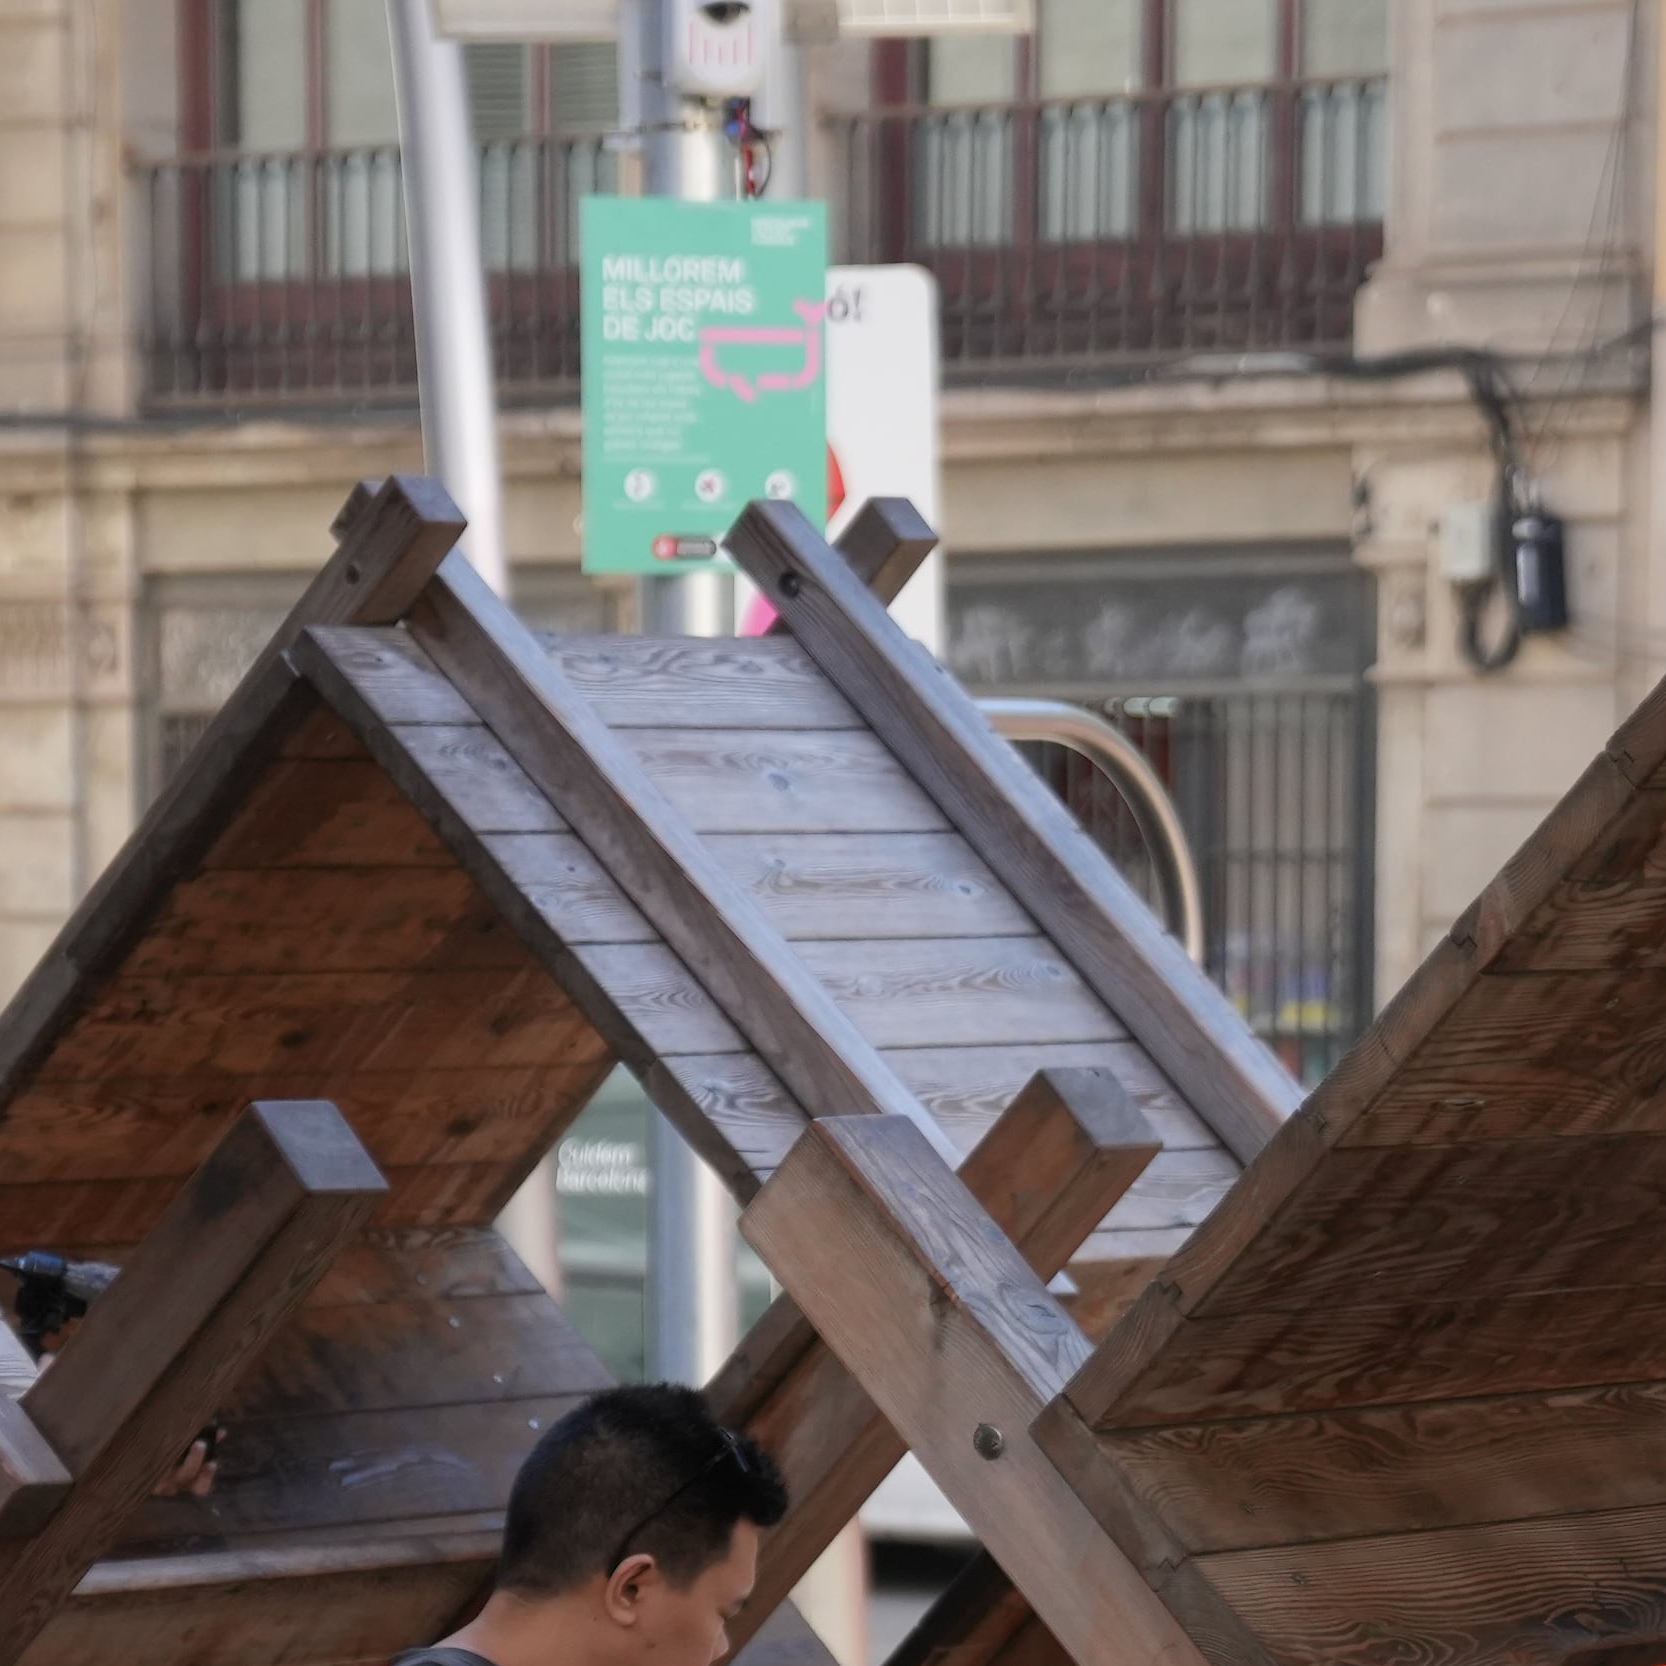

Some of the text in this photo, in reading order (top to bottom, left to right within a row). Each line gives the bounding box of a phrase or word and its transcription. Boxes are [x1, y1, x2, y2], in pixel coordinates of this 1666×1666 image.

[602, 256, 744, 283] MILLOREM
[602, 285, 755, 315] ELS ESPAIS
[603, 314, 696, 341] DE JOC
